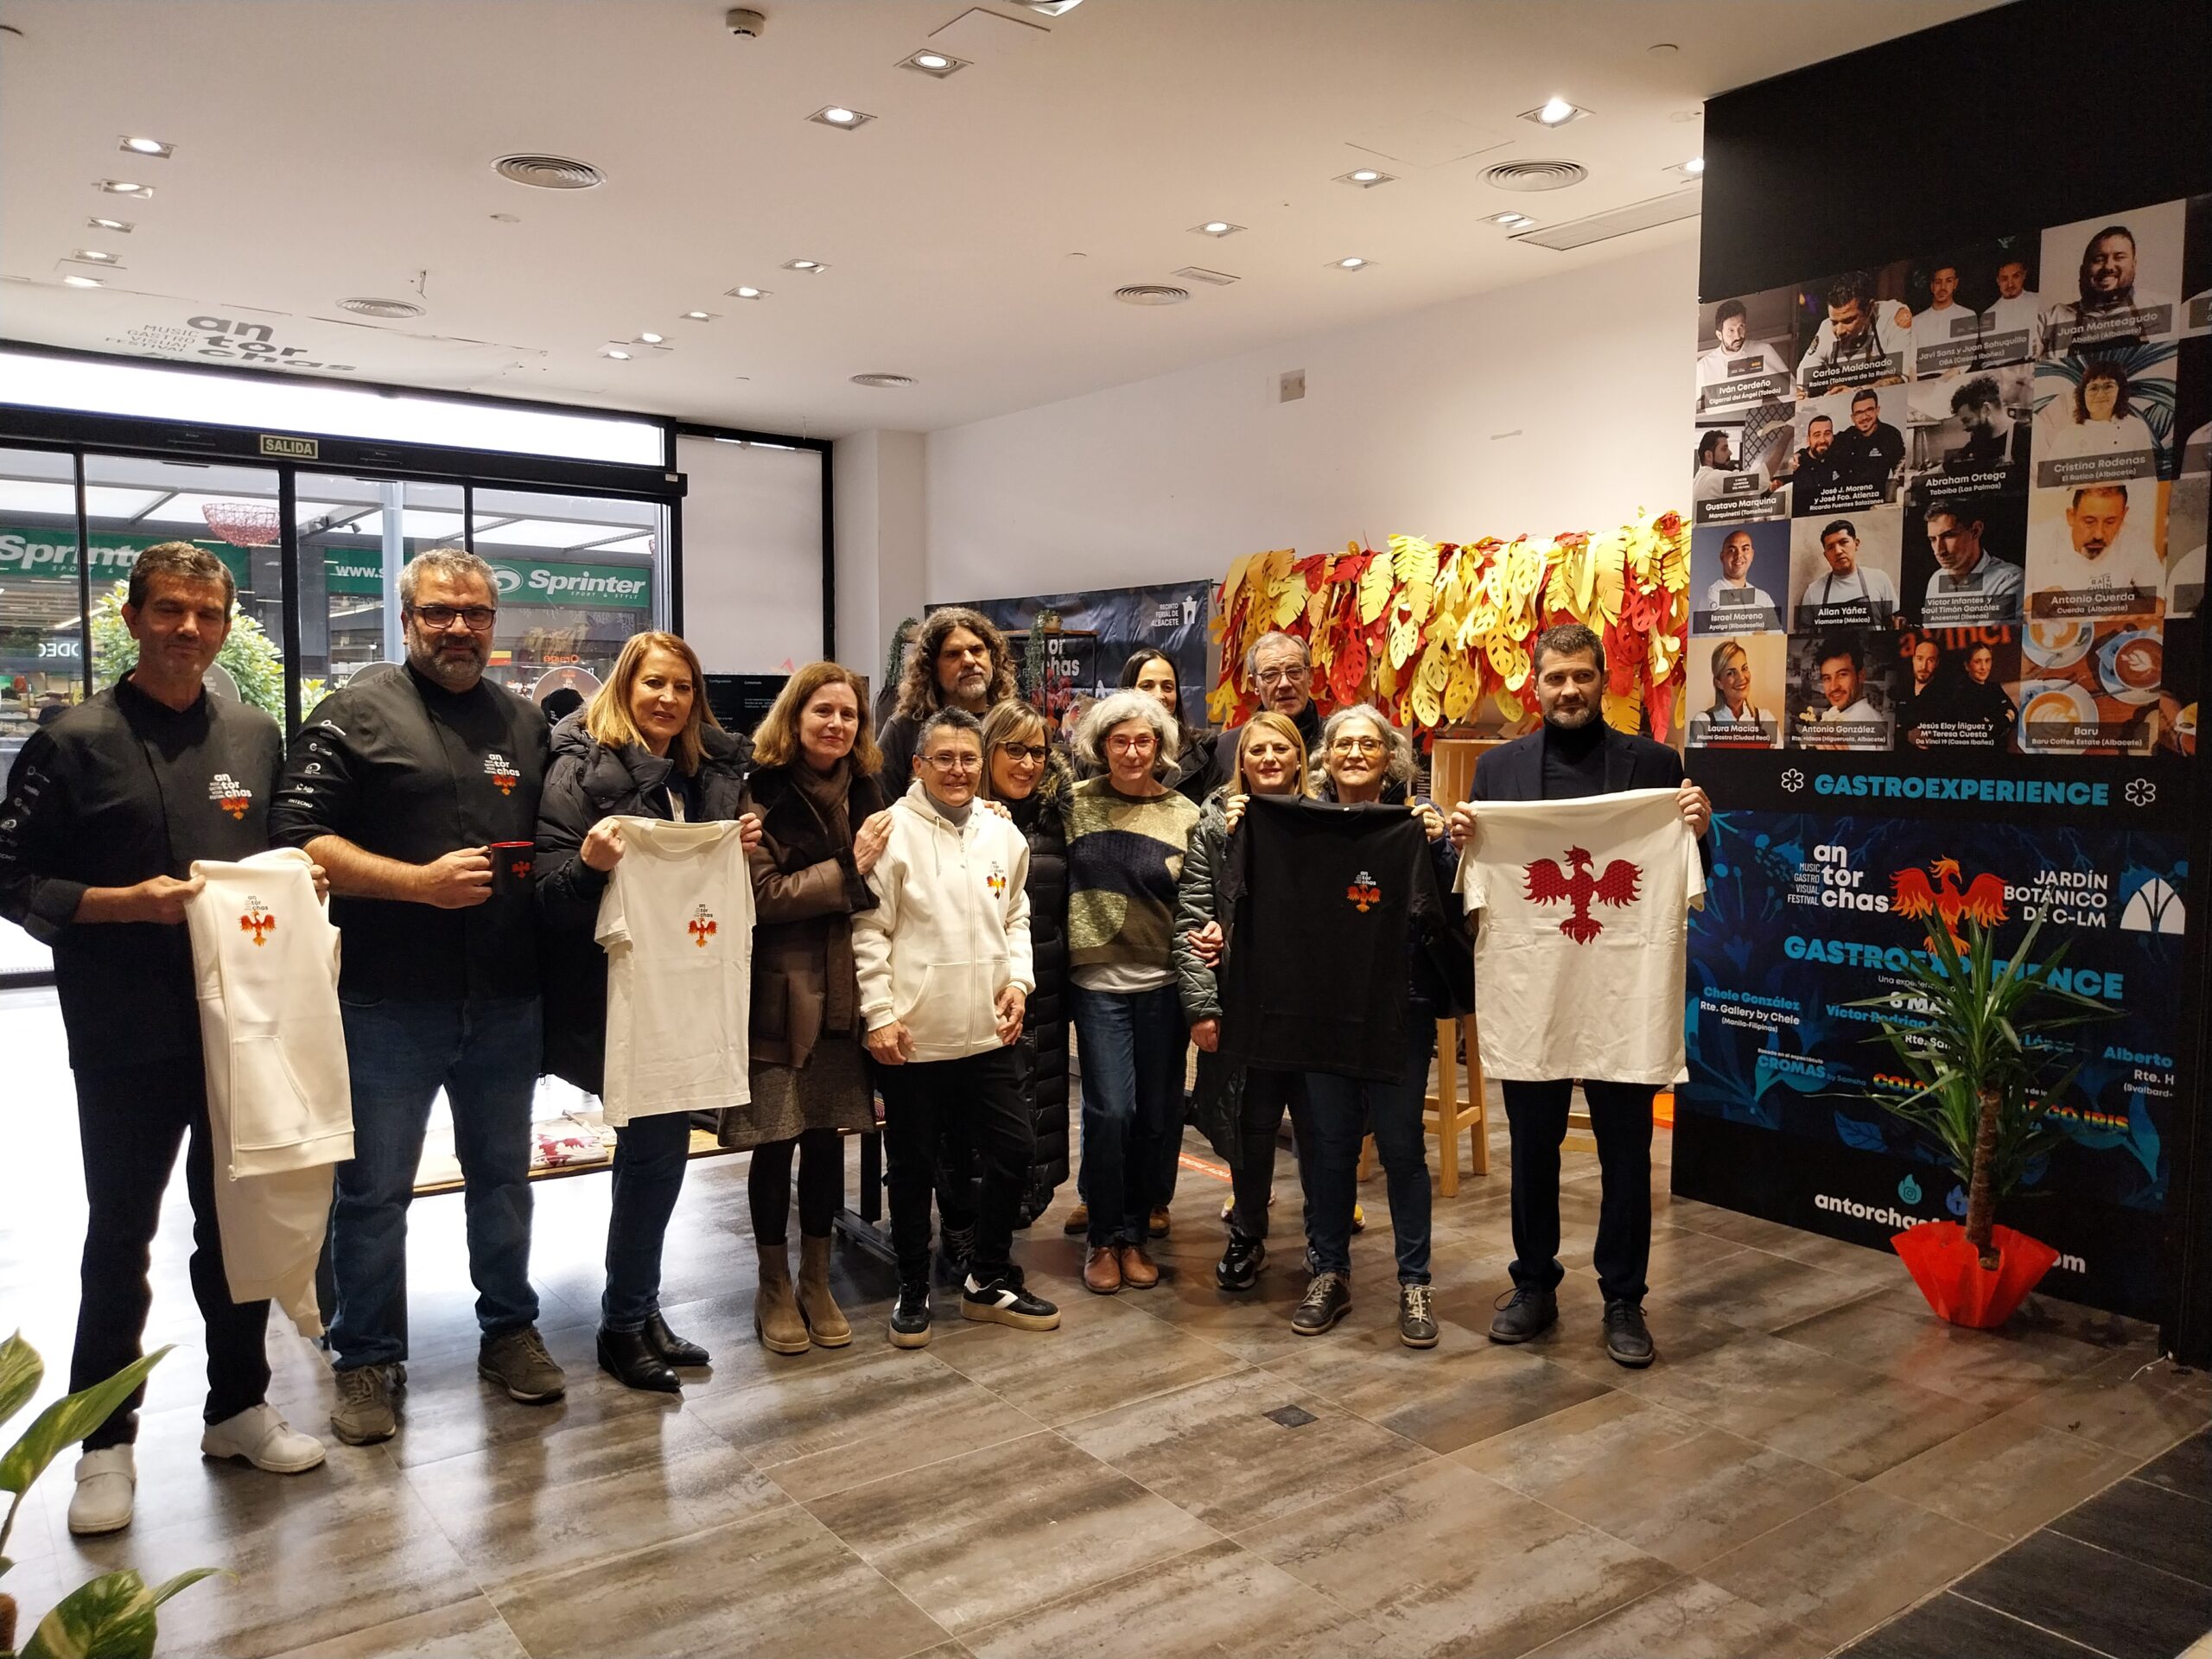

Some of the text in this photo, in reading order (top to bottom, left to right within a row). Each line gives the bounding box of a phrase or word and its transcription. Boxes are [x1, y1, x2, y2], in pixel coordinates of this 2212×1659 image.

[144, 324, 200, 338] MUSIC
[187, 315, 274, 342] an
[2056, 312, 2158, 338] Juan Monteagudo
[203, 335, 308, 357] tor
[1918, 351, 1936, 360] Javi
[1936, 347, 1955, 358] Sanz
[1962, 343, 1983, 353] Juan
[197, 349, 358, 372] chas
[1812, 359, 1893, 378] Carlos Maldonado
[1719, 378, 1771, 395] Iván Cerdeño
[1732, 393, 1741, 402] del
[264, 438, 314, 456] SALIDA
[2053, 454, 2146, 474] Cristina Rodenas
[1925, 470, 2006, 487] Abraham Ortega
[1821, 484, 1873, 496] José J. Moreno
[1929, 481, 2002, 496] Tabaiba (Las Palmas)
[1706, 497, 1777, 512] Gustavo Marquina
[1819, 494, 1836, 504] José
[1837, 493, 1852, 501] Fco.
[1809, 503, 1831, 512] Ricardo
[528, 569, 646, 595] Sprinter
[1951, 595, 1984, 605] Infantes
[2051, 591, 2135, 606] Antonio Cuerda
[1818, 605, 1867, 616] Allan Yáñez
[1963, 603, 1999, 613] González
[2056, 606, 2085, 614] Cuerda
[1733, 612, 1764, 620] Moreno
[1836, 725, 1875, 734] González
[2074, 727, 2098, 735] Baru
[213, 772, 232, 782] an
[497, 767, 520, 776] chas
[221, 781, 239, 790] tor
[1815, 774, 2108, 806] GASTROEXPERIENCE
[225, 789, 252, 798] chas
[1814, 843, 1847, 867] an
[1799, 862, 1821, 873] MUSIC
[1794, 874, 1820, 883] GASTRO
[1821, 864, 1864, 887] tor
[2033, 868, 2108, 890] JARDÍN
[1796, 884, 1820, 895] VISUAL
[1787, 893, 1819, 906] FESTIVAL
[1821, 887, 1890, 913] chas
[2004, 885, 2108, 910] BOTÁNICO
[2052, 909, 2107, 928] C-LM
[1878, 976, 1894, 984] Una
[1703, 986, 1801, 1011] Chele González
[1700, 1001, 1801, 1026] Rte. Gallery by Chele
[2103, 1046, 2173, 1069] Alberto
[1758, 1055, 1826, 1079] CROMAS
[2133, 1069, 2161, 1084] Rte.
[2123, 1083, 2173, 1098] (Svalbard-
